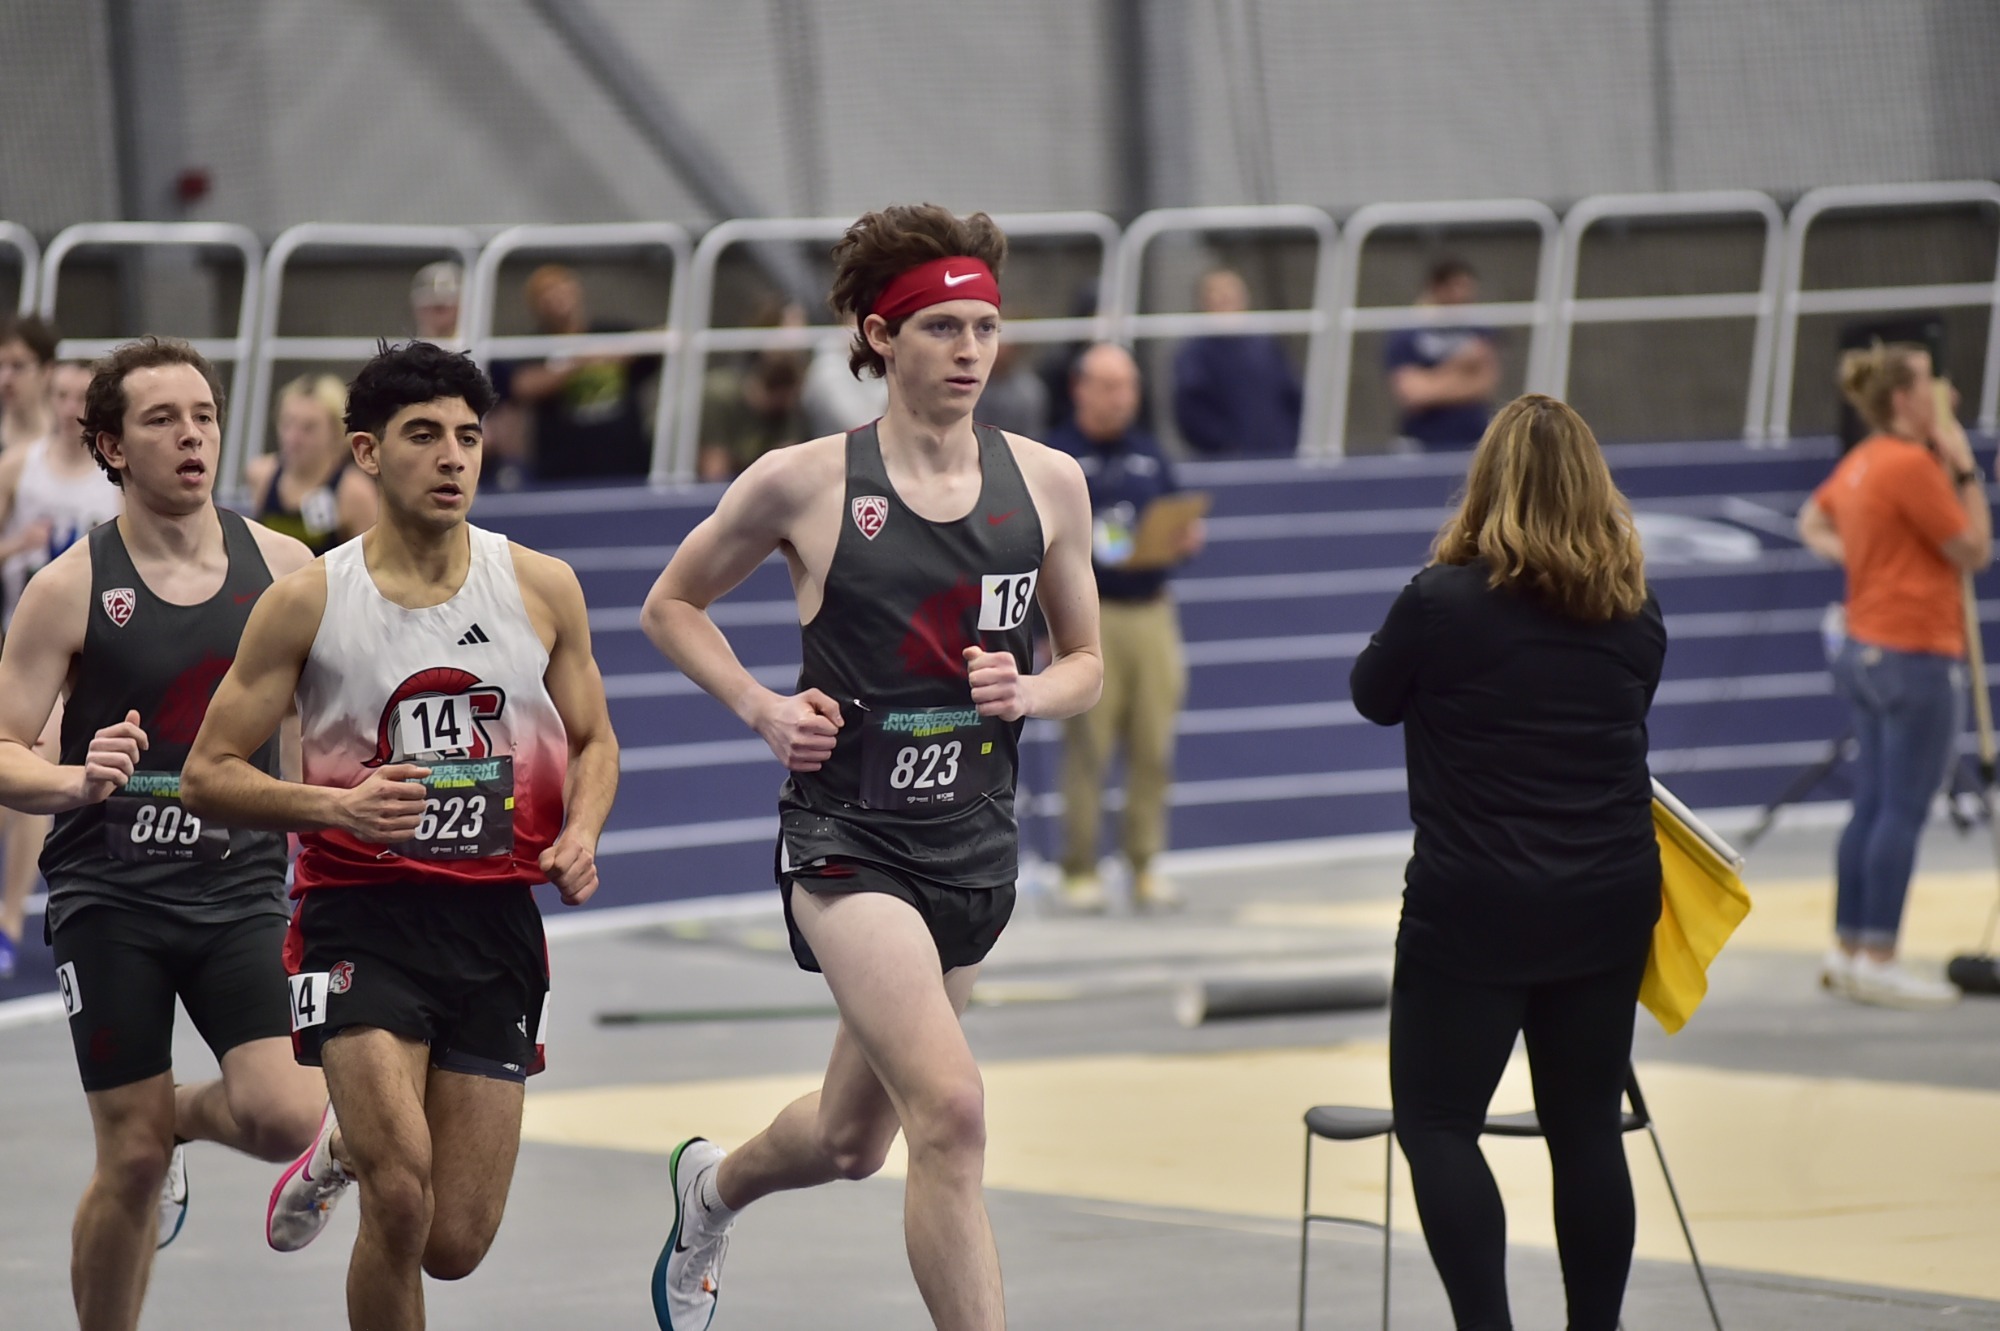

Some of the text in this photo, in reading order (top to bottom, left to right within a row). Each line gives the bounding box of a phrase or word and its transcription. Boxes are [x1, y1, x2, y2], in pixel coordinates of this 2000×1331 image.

[861, 514, 879, 530] 12
[112, 604, 128, 619] 12
[994, 576, 1031, 627] 18
[411, 698, 461, 749] 14
[882, 717, 982, 732] INVITATIONAL
[887, 709, 981, 722] RIVERFRONT
[430, 761, 500, 775] VERFRONT
[889, 740, 962, 789] 823
[130, 804, 201, 845] 805
[414, 795, 487, 841] 623
